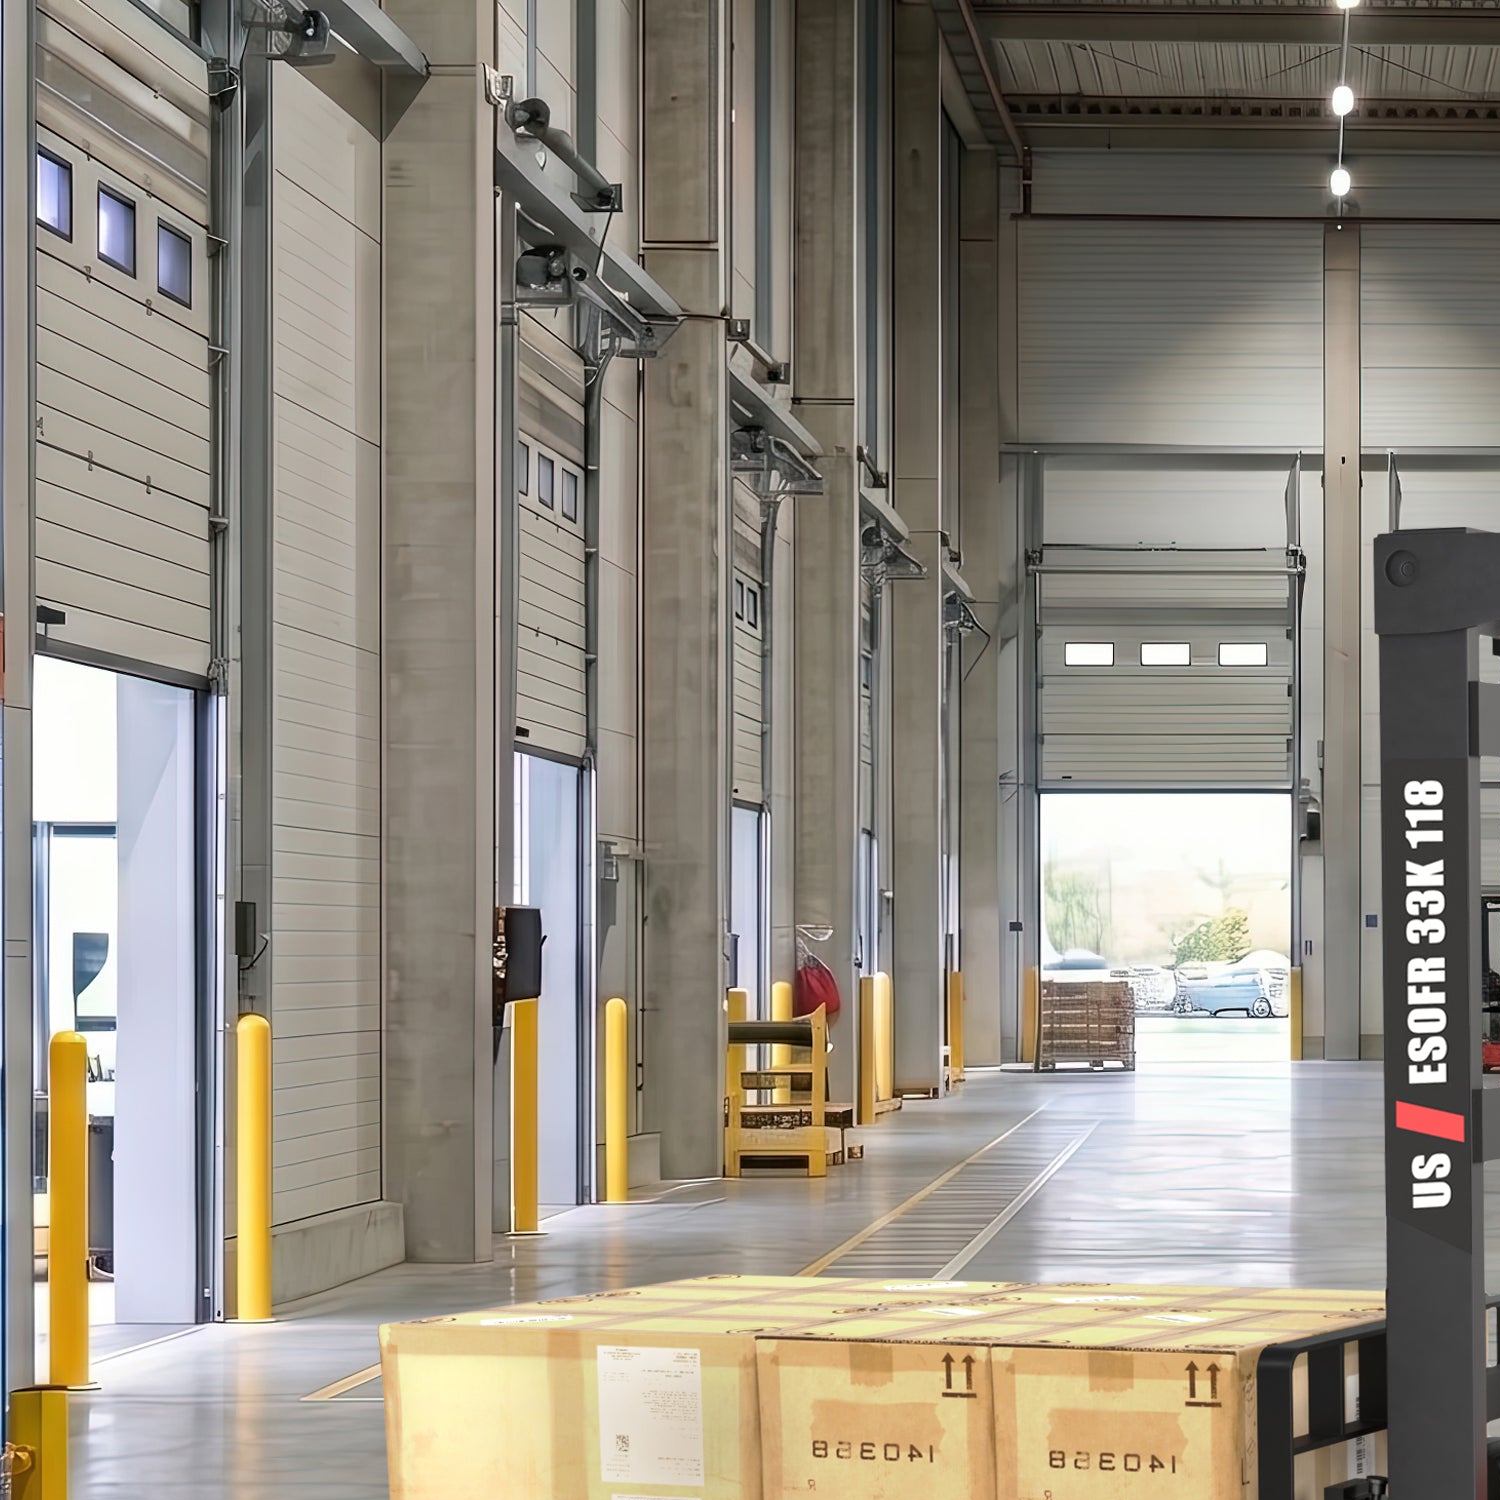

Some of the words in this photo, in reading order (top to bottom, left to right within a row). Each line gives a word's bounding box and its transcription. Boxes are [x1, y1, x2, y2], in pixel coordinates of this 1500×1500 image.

[1403, 779, 1445, 849] 118
[1404, 859, 1446, 945] 33K
[1406, 956, 1448, 1085] ESOFR
[1411, 1152, 1452, 1209] US
